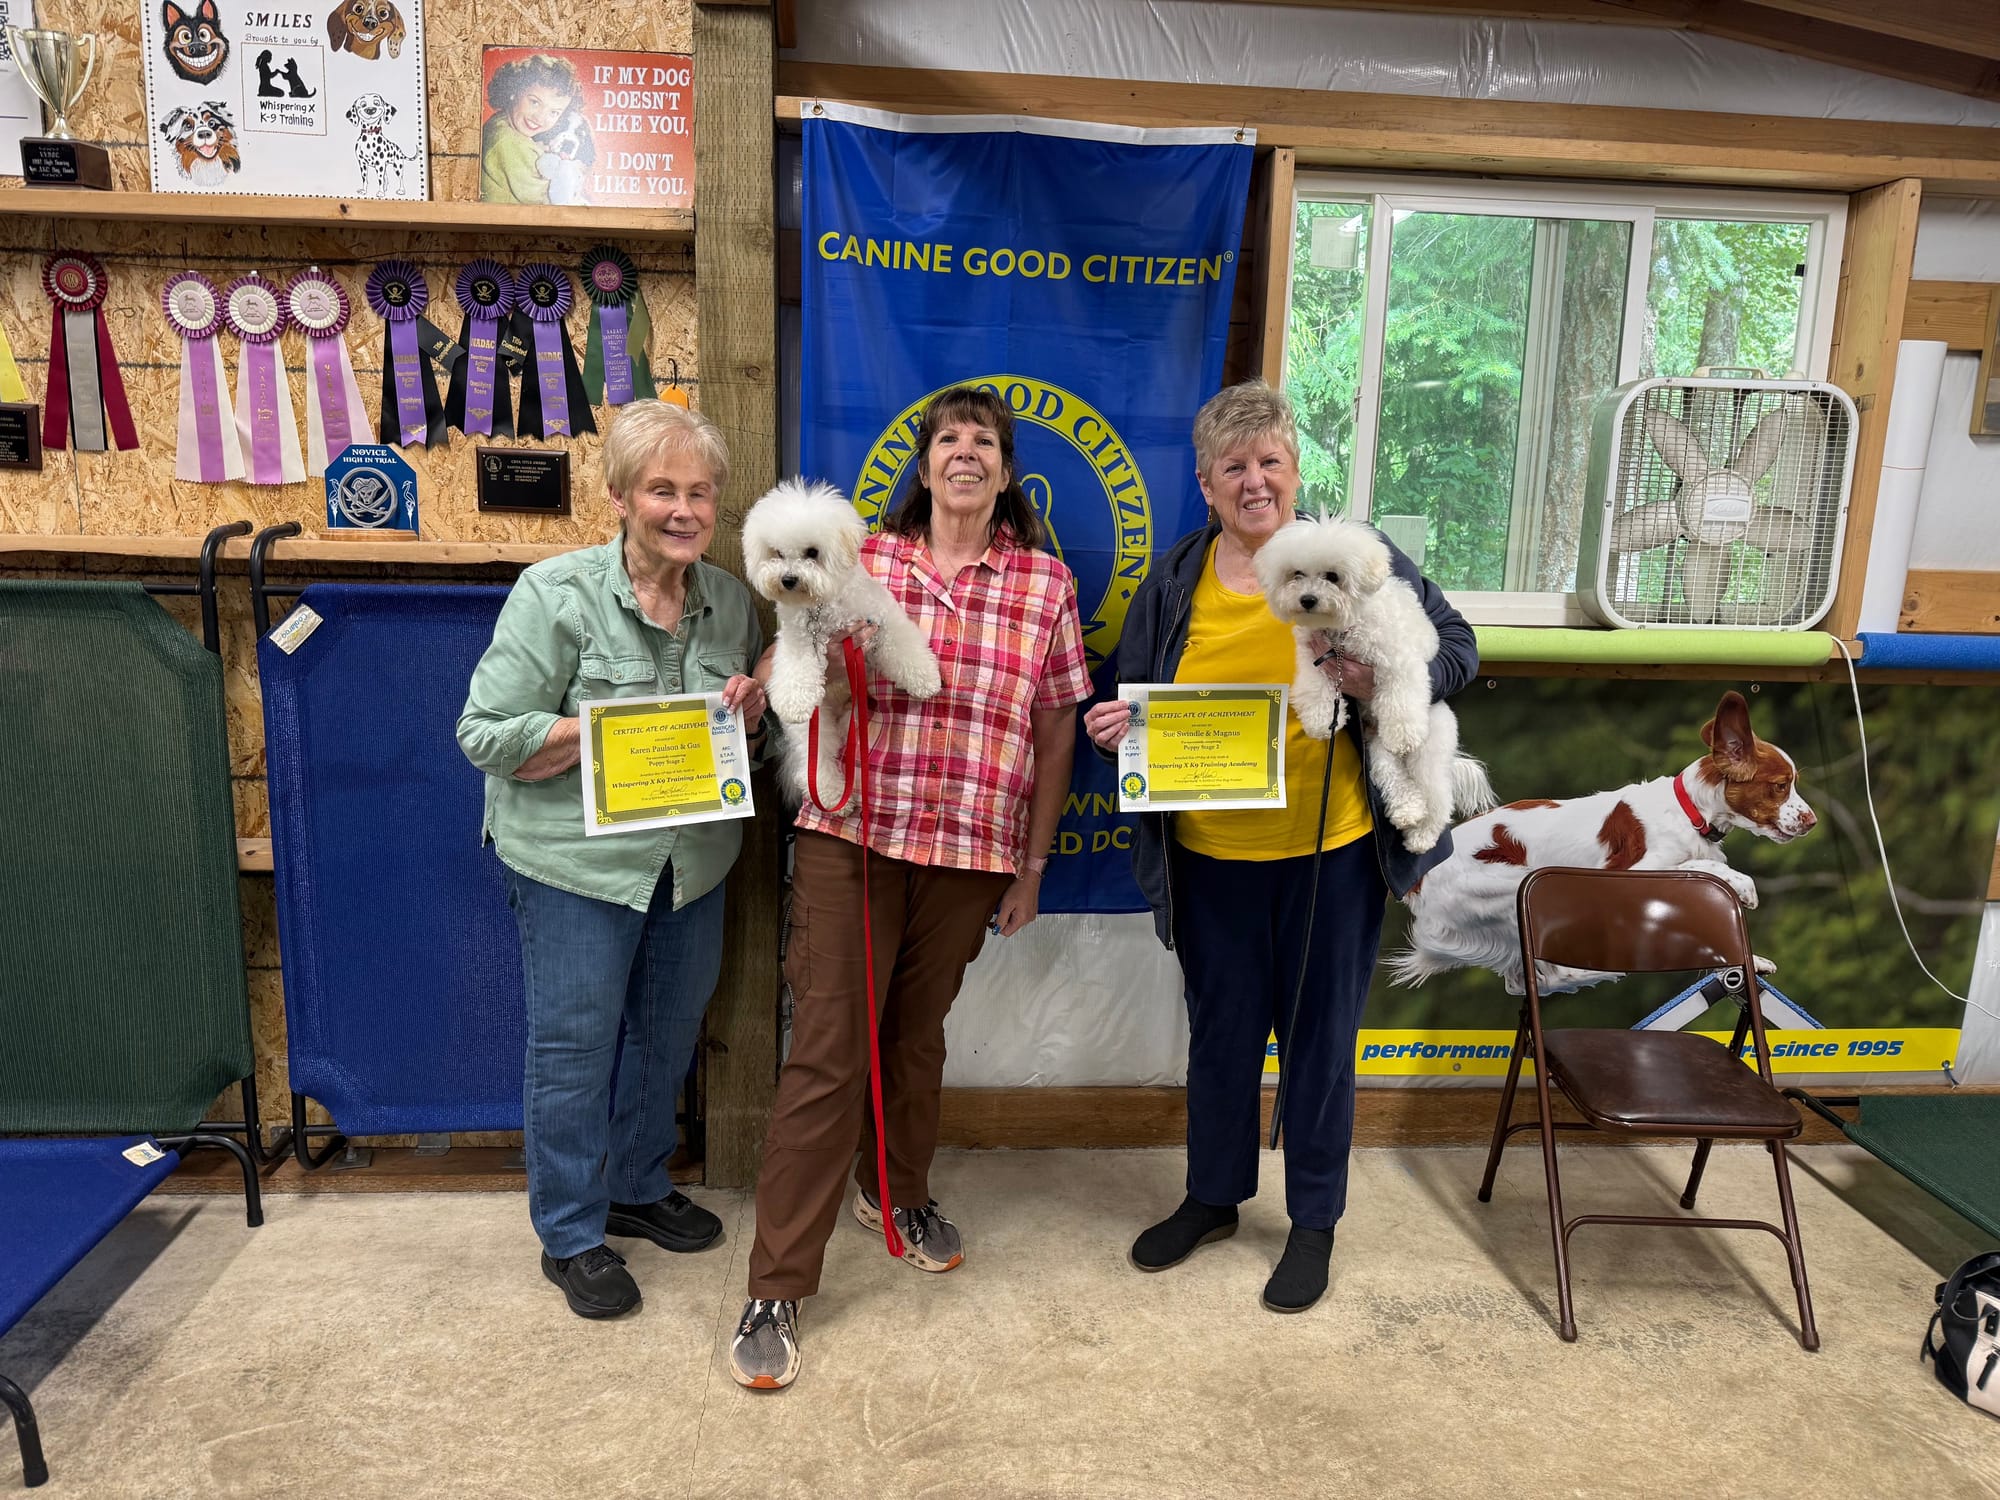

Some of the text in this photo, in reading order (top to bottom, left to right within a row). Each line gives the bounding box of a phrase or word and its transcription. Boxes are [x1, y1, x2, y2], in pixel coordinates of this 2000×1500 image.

[245, 12, 312, 28] SMILES
[245, 33, 278, 43] Brought
[310, 36, 318, 46] by
[593, 66, 690, 87] IF MY DOG
[260, 101, 307, 113] Whispering
[603, 90, 681, 111] DOESN'T
[260, 112, 314, 127] K-9 Training
[595, 113, 689, 137] LIKE YOU,
[606, 151, 674, 172] I DON'T
[593, 175, 688, 196] LIKE YOU.
[817, 231, 953, 273] CANINE
[962, 247, 1072, 281] GOOD
[343, 456, 363, 464] HIGH
[374, 457, 397, 465] TRIAL
[351, 448, 388, 457] NOVICE
[1073, 415, 1147, 583] CITIZEN
[1213, 730, 1241, 738] Magnus
[630, 746, 651, 755] Karen
[652, 744, 679, 752] Paulson
[687, 742, 701, 750] Gus
[612, 780, 649, 789] Whispering
[667, 774, 694, 783] Training
[1771, 1041, 1838, 1057] since
[1847, 1040, 1905, 1057] 1995
